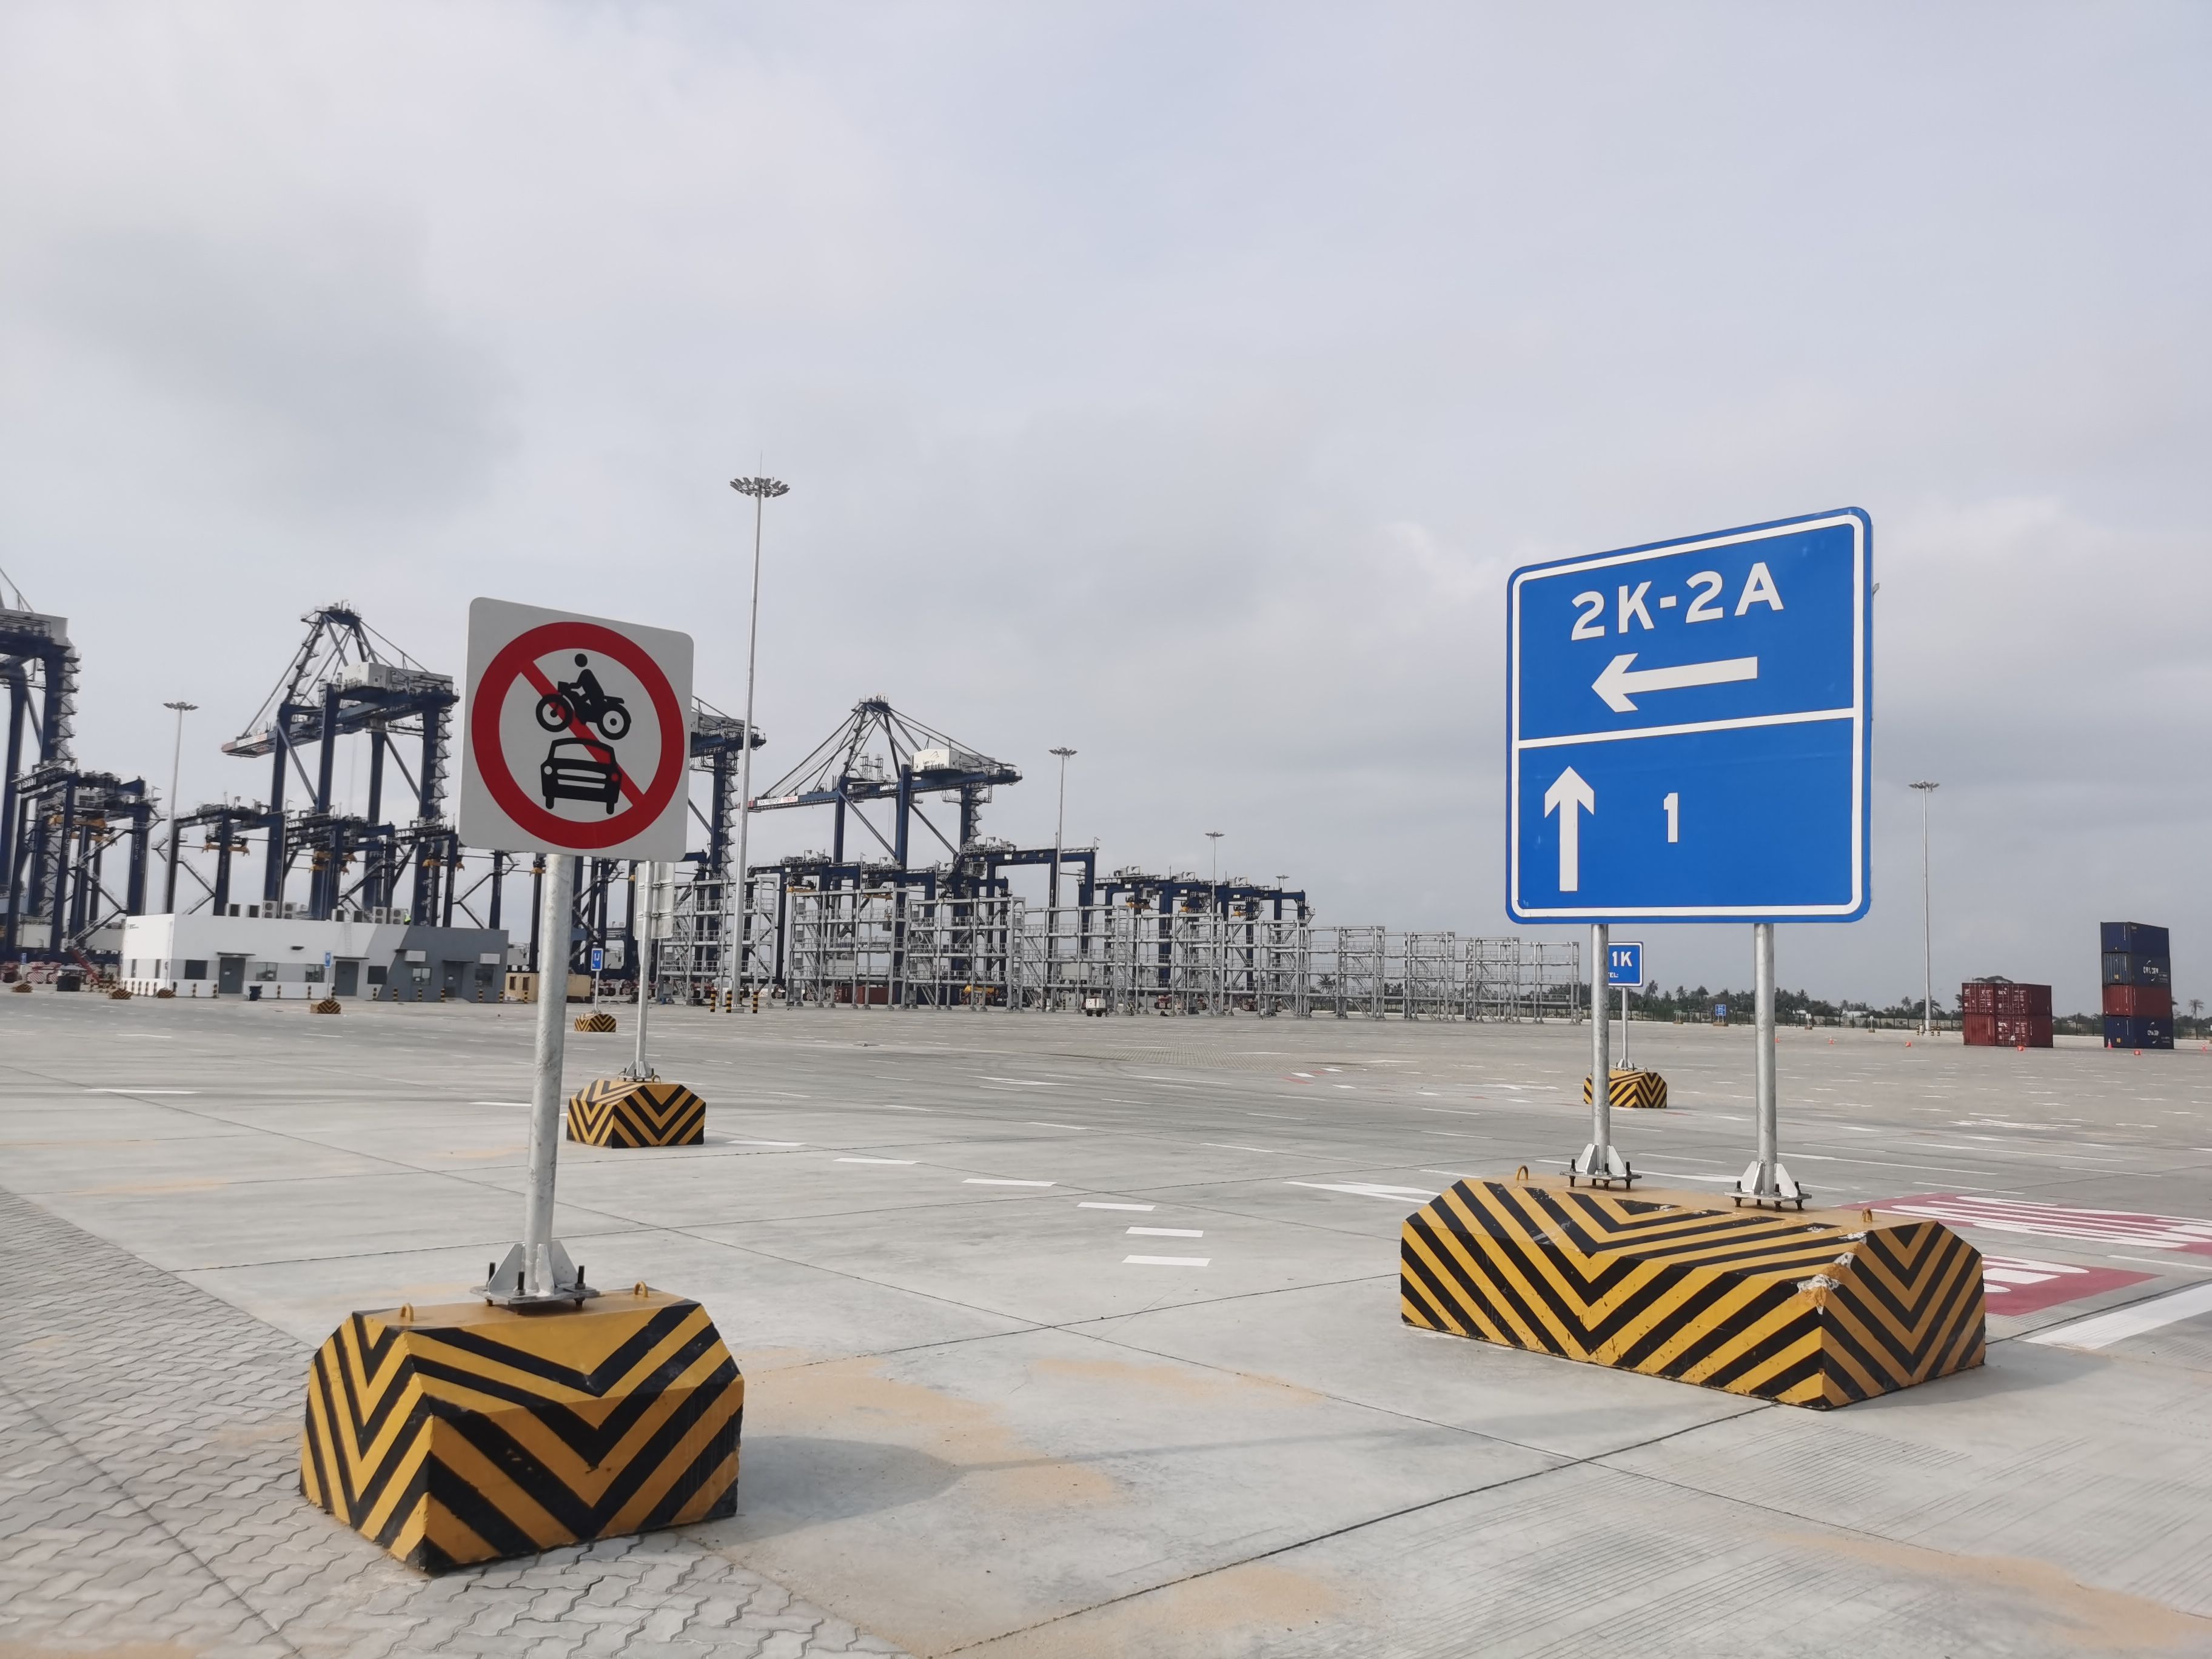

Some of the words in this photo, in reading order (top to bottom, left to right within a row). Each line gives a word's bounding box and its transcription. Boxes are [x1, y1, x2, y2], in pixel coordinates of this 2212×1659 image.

[1571, 561, 1784, 641] 2K-2A
[1663, 792, 1678, 843] 1
[1612, 951, 1632, 967] 1K
